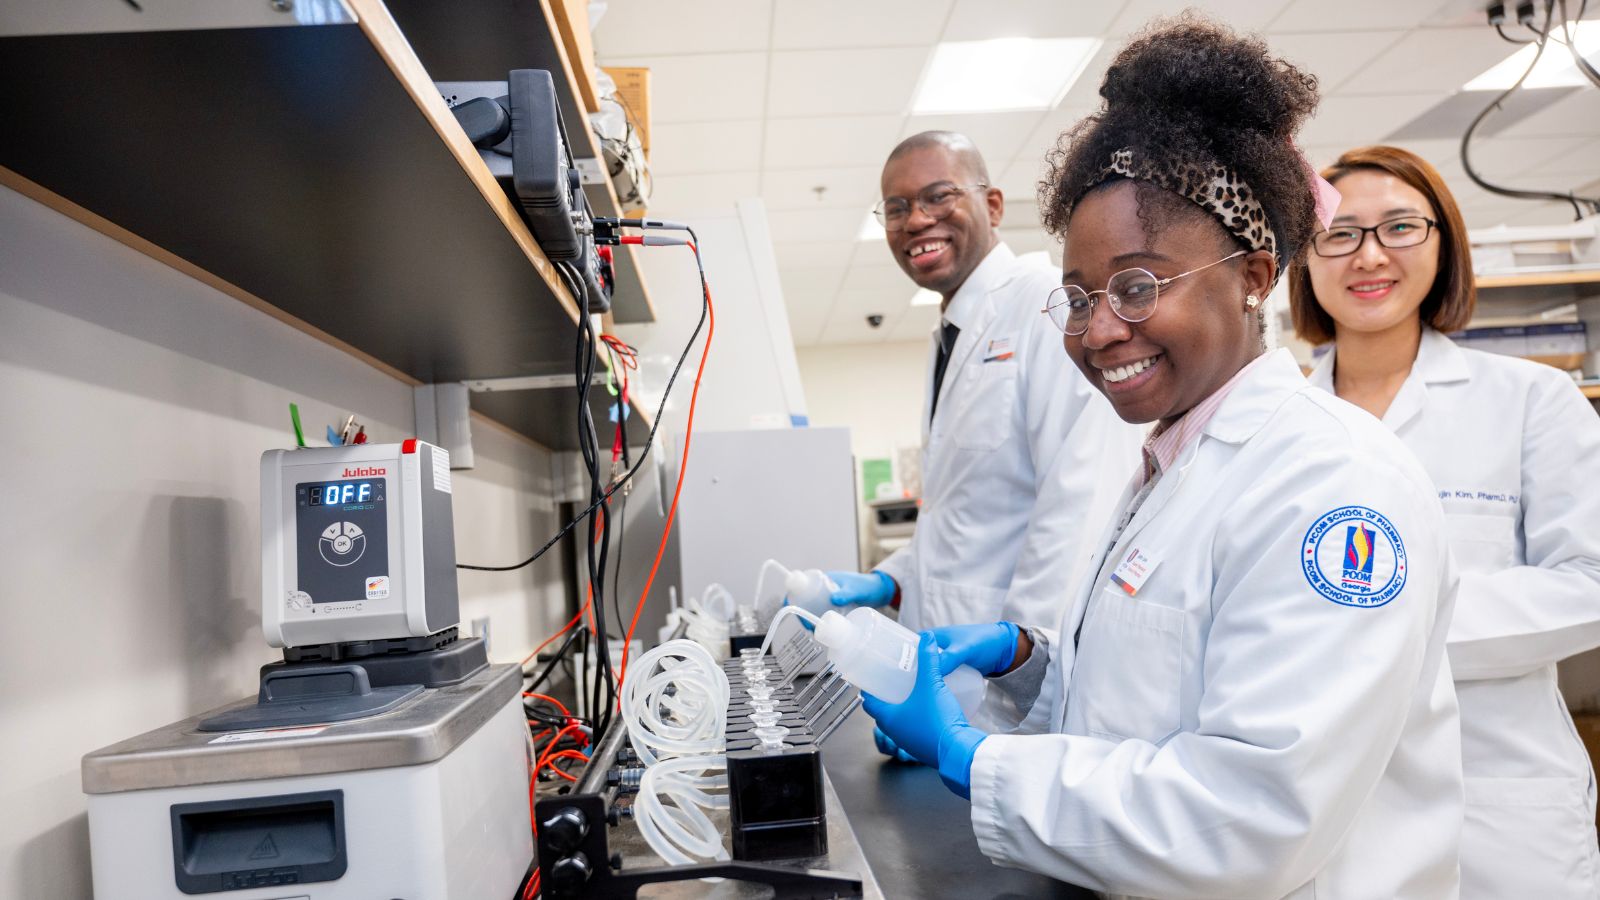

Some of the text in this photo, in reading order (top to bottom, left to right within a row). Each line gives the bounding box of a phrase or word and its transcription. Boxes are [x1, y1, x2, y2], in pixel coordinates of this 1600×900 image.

[342, 467, 386, 478] Julabo
[326, 483, 371, 505] OFF
[1308, 509, 1404, 560] PCOM SCHOOL OF PHARMACY
[1305, 559, 1403, 604] PCOM SCHOOL OF PHARMACY
[1342, 570, 1372, 583] PCOM
[1341, 582, 1371, 592] Georgia
